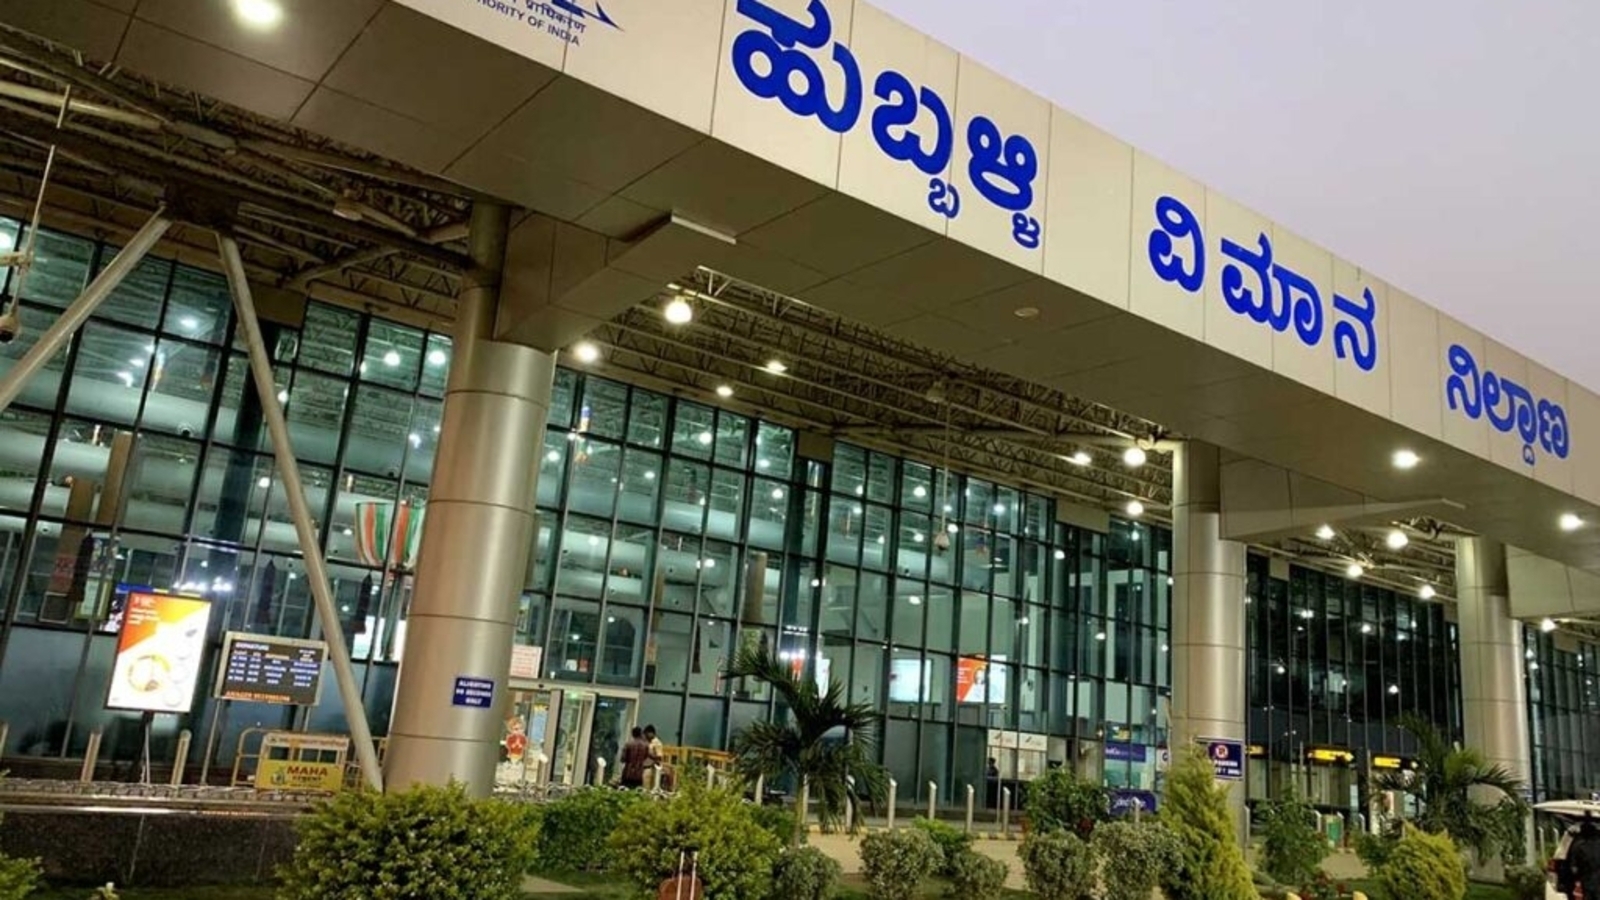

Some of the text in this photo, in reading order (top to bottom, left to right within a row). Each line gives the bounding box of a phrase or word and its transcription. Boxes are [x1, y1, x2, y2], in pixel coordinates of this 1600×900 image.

[528, 15, 546, 29] OF
[548, 24, 580, 46] INDIA
[732, 0, 1569, 466] ಹುಬ್ಬಳ್ಳಿ ವಿಮಾನ ನಿಲ್ದಾಣ
[287, 766, 328, 777] MAHA
